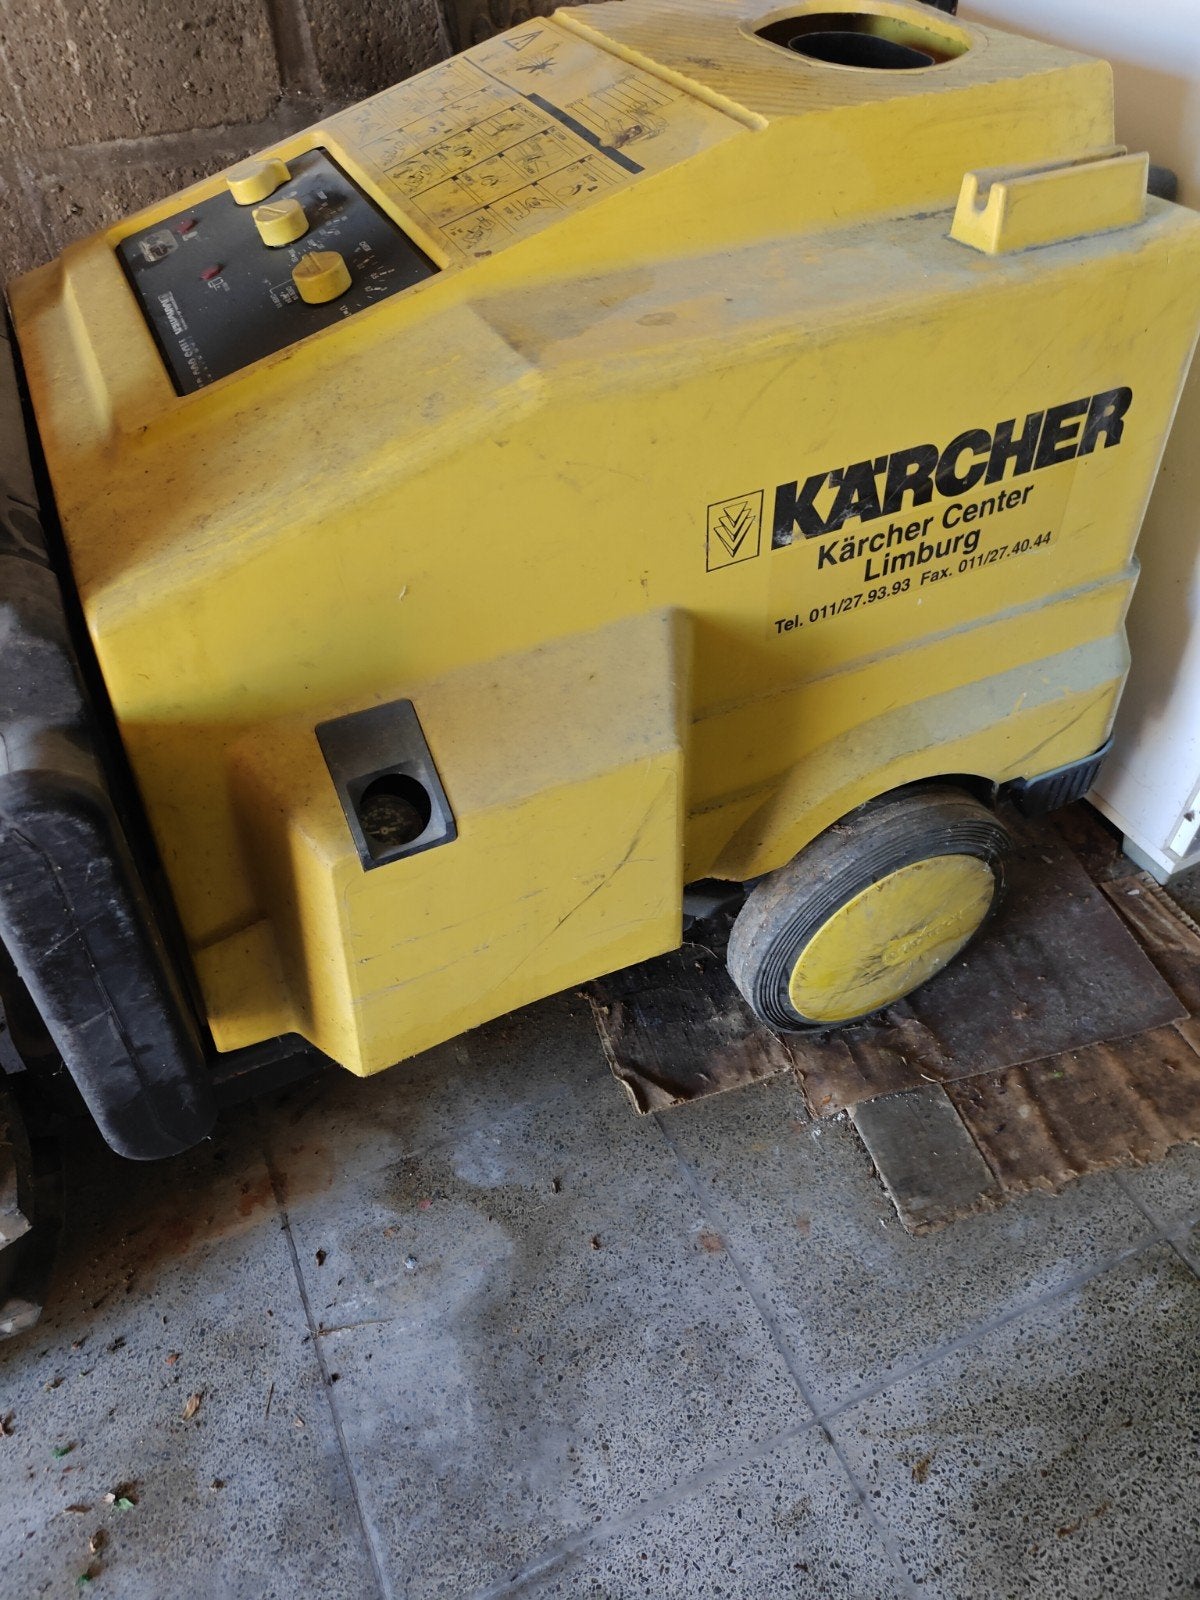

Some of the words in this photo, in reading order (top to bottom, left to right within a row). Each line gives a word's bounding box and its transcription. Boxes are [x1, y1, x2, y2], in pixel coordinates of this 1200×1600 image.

[771, 386, 1132, 550] KÄRCHER
[817, 516, 934, 569] Kärcher
[942, 485, 1034, 529] Center
[863, 528, 981, 582] Limburg
[774, 614, 803, 634] Tel.
[809, 578, 911, 623] 011/27.93.93
[920, 567, 952, 586] Fax.
[958, 531, 1052, 573] 011/27.40.44
